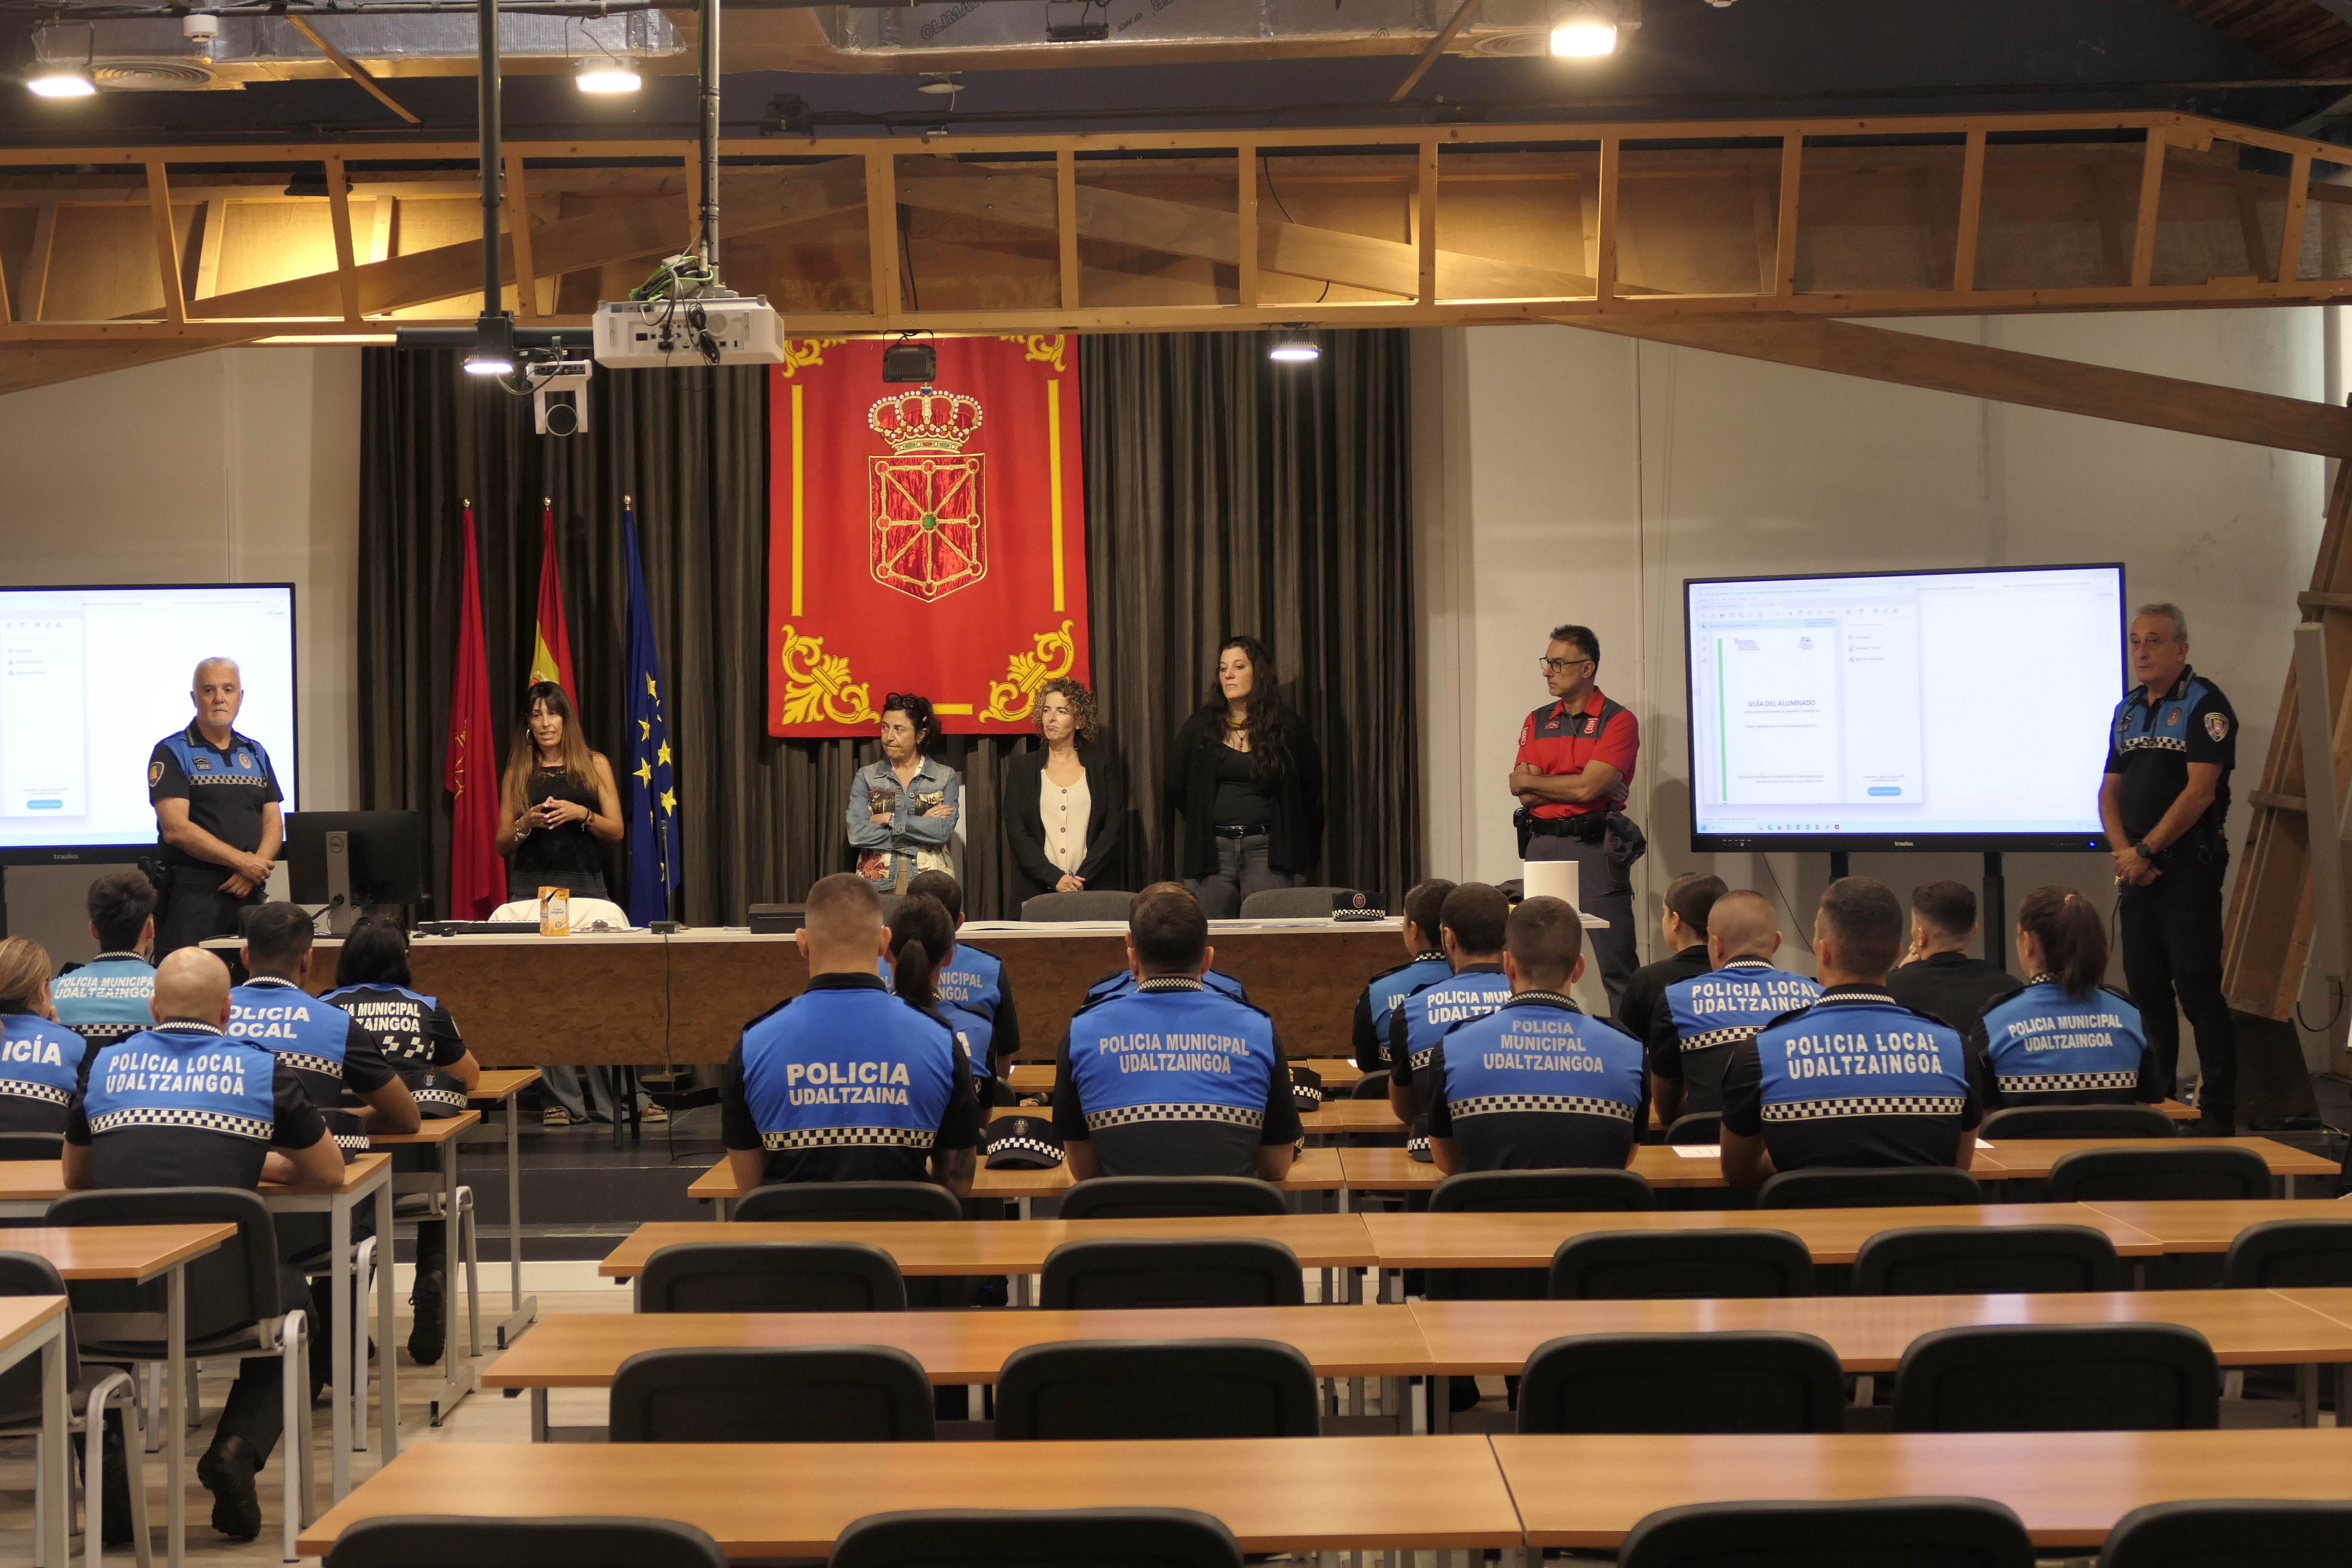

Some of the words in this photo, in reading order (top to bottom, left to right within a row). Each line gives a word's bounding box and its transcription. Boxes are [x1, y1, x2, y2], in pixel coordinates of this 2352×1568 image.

[921, 0, 984, 40] CLIMAV
[57, 977, 98, 989] POLICIA
[101, 976, 154, 988] MUNICIPA
[938, 971, 983, 989] NICIPAL
[1692, 982, 1762, 998] POLICIA
[1767, 981, 1821, 998] LOCAL
[1428, 991, 1480, 1008] POLICIA
[229, 1005, 310, 1022] OLICIA
[357, 1002, 421, 1018] MUNICIPAL
[224, 1022, 298, 1039] OCAL
[1513, 1020, 1574, 1035] POLICIA
[2008, 1016, 2057, 1038] POLICIA
[2058, 1014, 2123, 1030] MUNICIPAL
[1, 1034, 62, 1067] ICÍA
[1099, 1033, 1162, 1055] POLICIA
[1166, 1033, 1250, 1057] MUNICIPAL
[1501, 1035, 1586, 1052] MUNICIPAL
[1786, 1033, 1869, 1058] POLICIA
[1876, 1032, 1939, 1053] LOCAL
[2024, 1033, 2113, 1053] UDALTZAINGOA
[108, 1052, 179, 1073] POLICIA
[186, 1054, 245, 1075] LOCAL
[1119, 1053, 1231, 1075] UDALTZAINGOA
[1483, 1053, 1604, 1074] UDALTZAINGOA
[1788, 1054, 1943, 1080] UDALTZAINGOA
[105, 1072, 245, 1096] UDALTZAINGOA
[786, 1061, 910, 1087] POLICIA
[789, 1087, 909, 1106] UDALTZAINA
